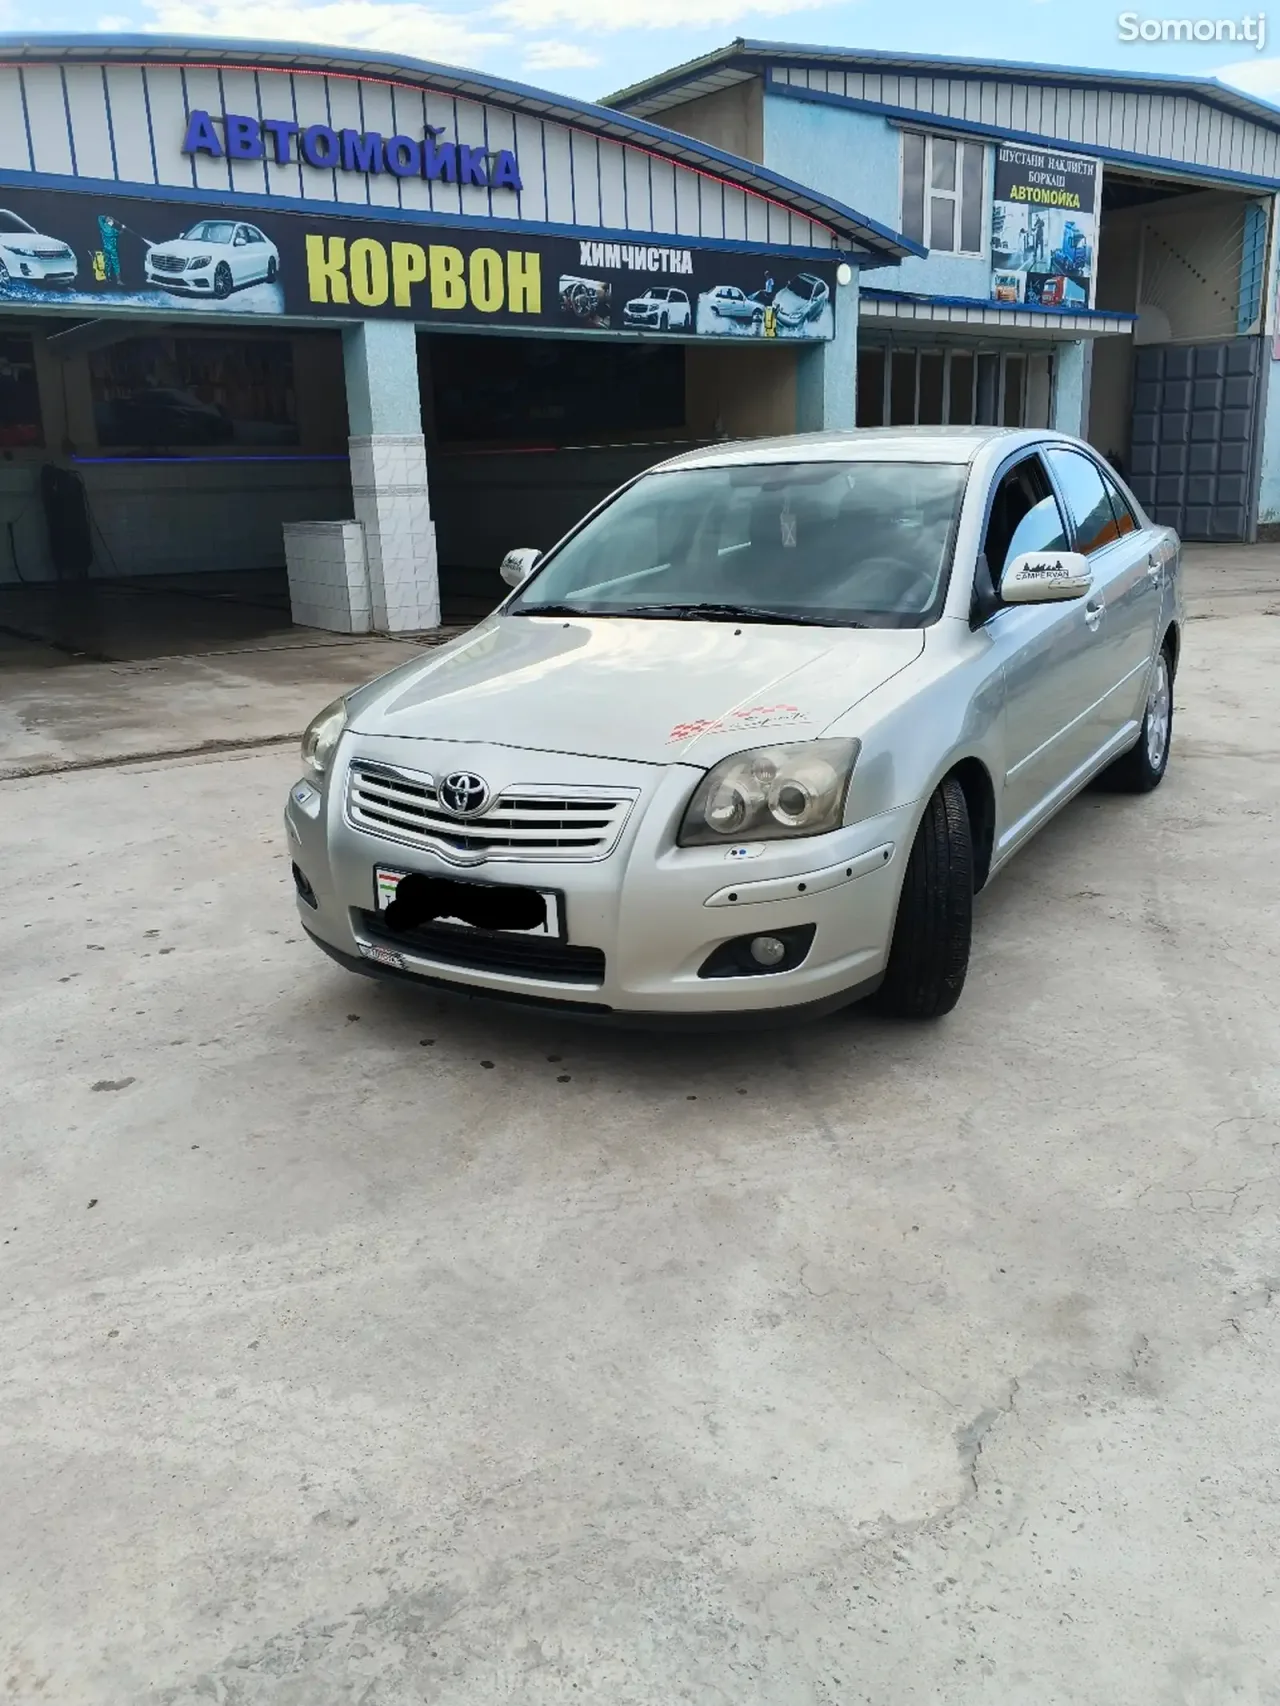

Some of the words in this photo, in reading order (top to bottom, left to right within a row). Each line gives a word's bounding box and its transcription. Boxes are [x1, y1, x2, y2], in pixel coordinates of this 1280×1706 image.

[182, 109, 524, 190] АВТОМОЙКА
[1028, 171, 1066, 187] БОРКАШ
[1010, 186, 1080, 208] АВТОМОЙКА
[580, 241, 693, 274] ХИМЧИСТКА
[305, 234, 543, 315] КОРВОН
[1015, 571, 1069, 580] CAMPERVAN
